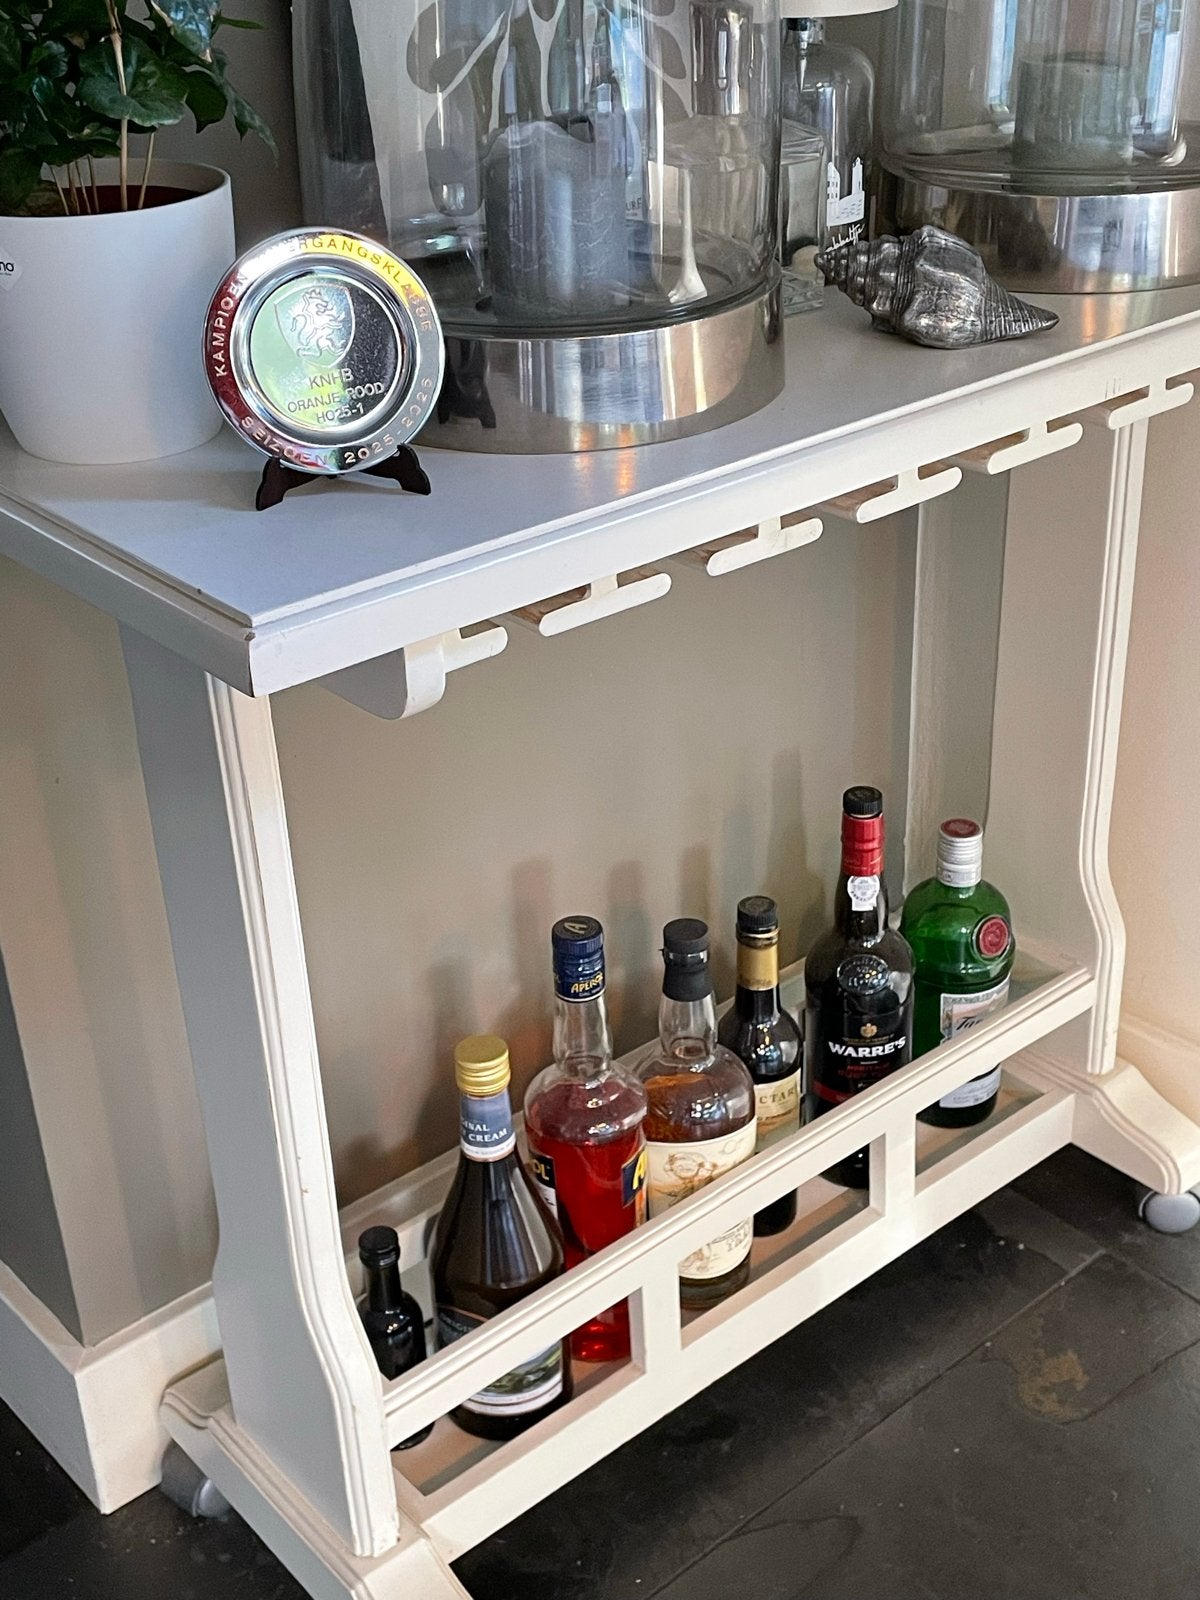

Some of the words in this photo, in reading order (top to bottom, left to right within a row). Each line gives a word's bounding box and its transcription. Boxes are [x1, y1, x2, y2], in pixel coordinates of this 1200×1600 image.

[289, 235, 432, 331] RGANGSKLASSE
[213, 272, 249, 377] KAMPIOEN
[309, 367, 354, 390] KNHB
[287, 392, 341, 413] ORANJE
[345, 382, 385, 400] ROOD
[241, 416, 328, 466] SEIZOEN
[828, 1035, 907, 1058] WARRE'S
[468, 1127, 509, 1143] CREAM
